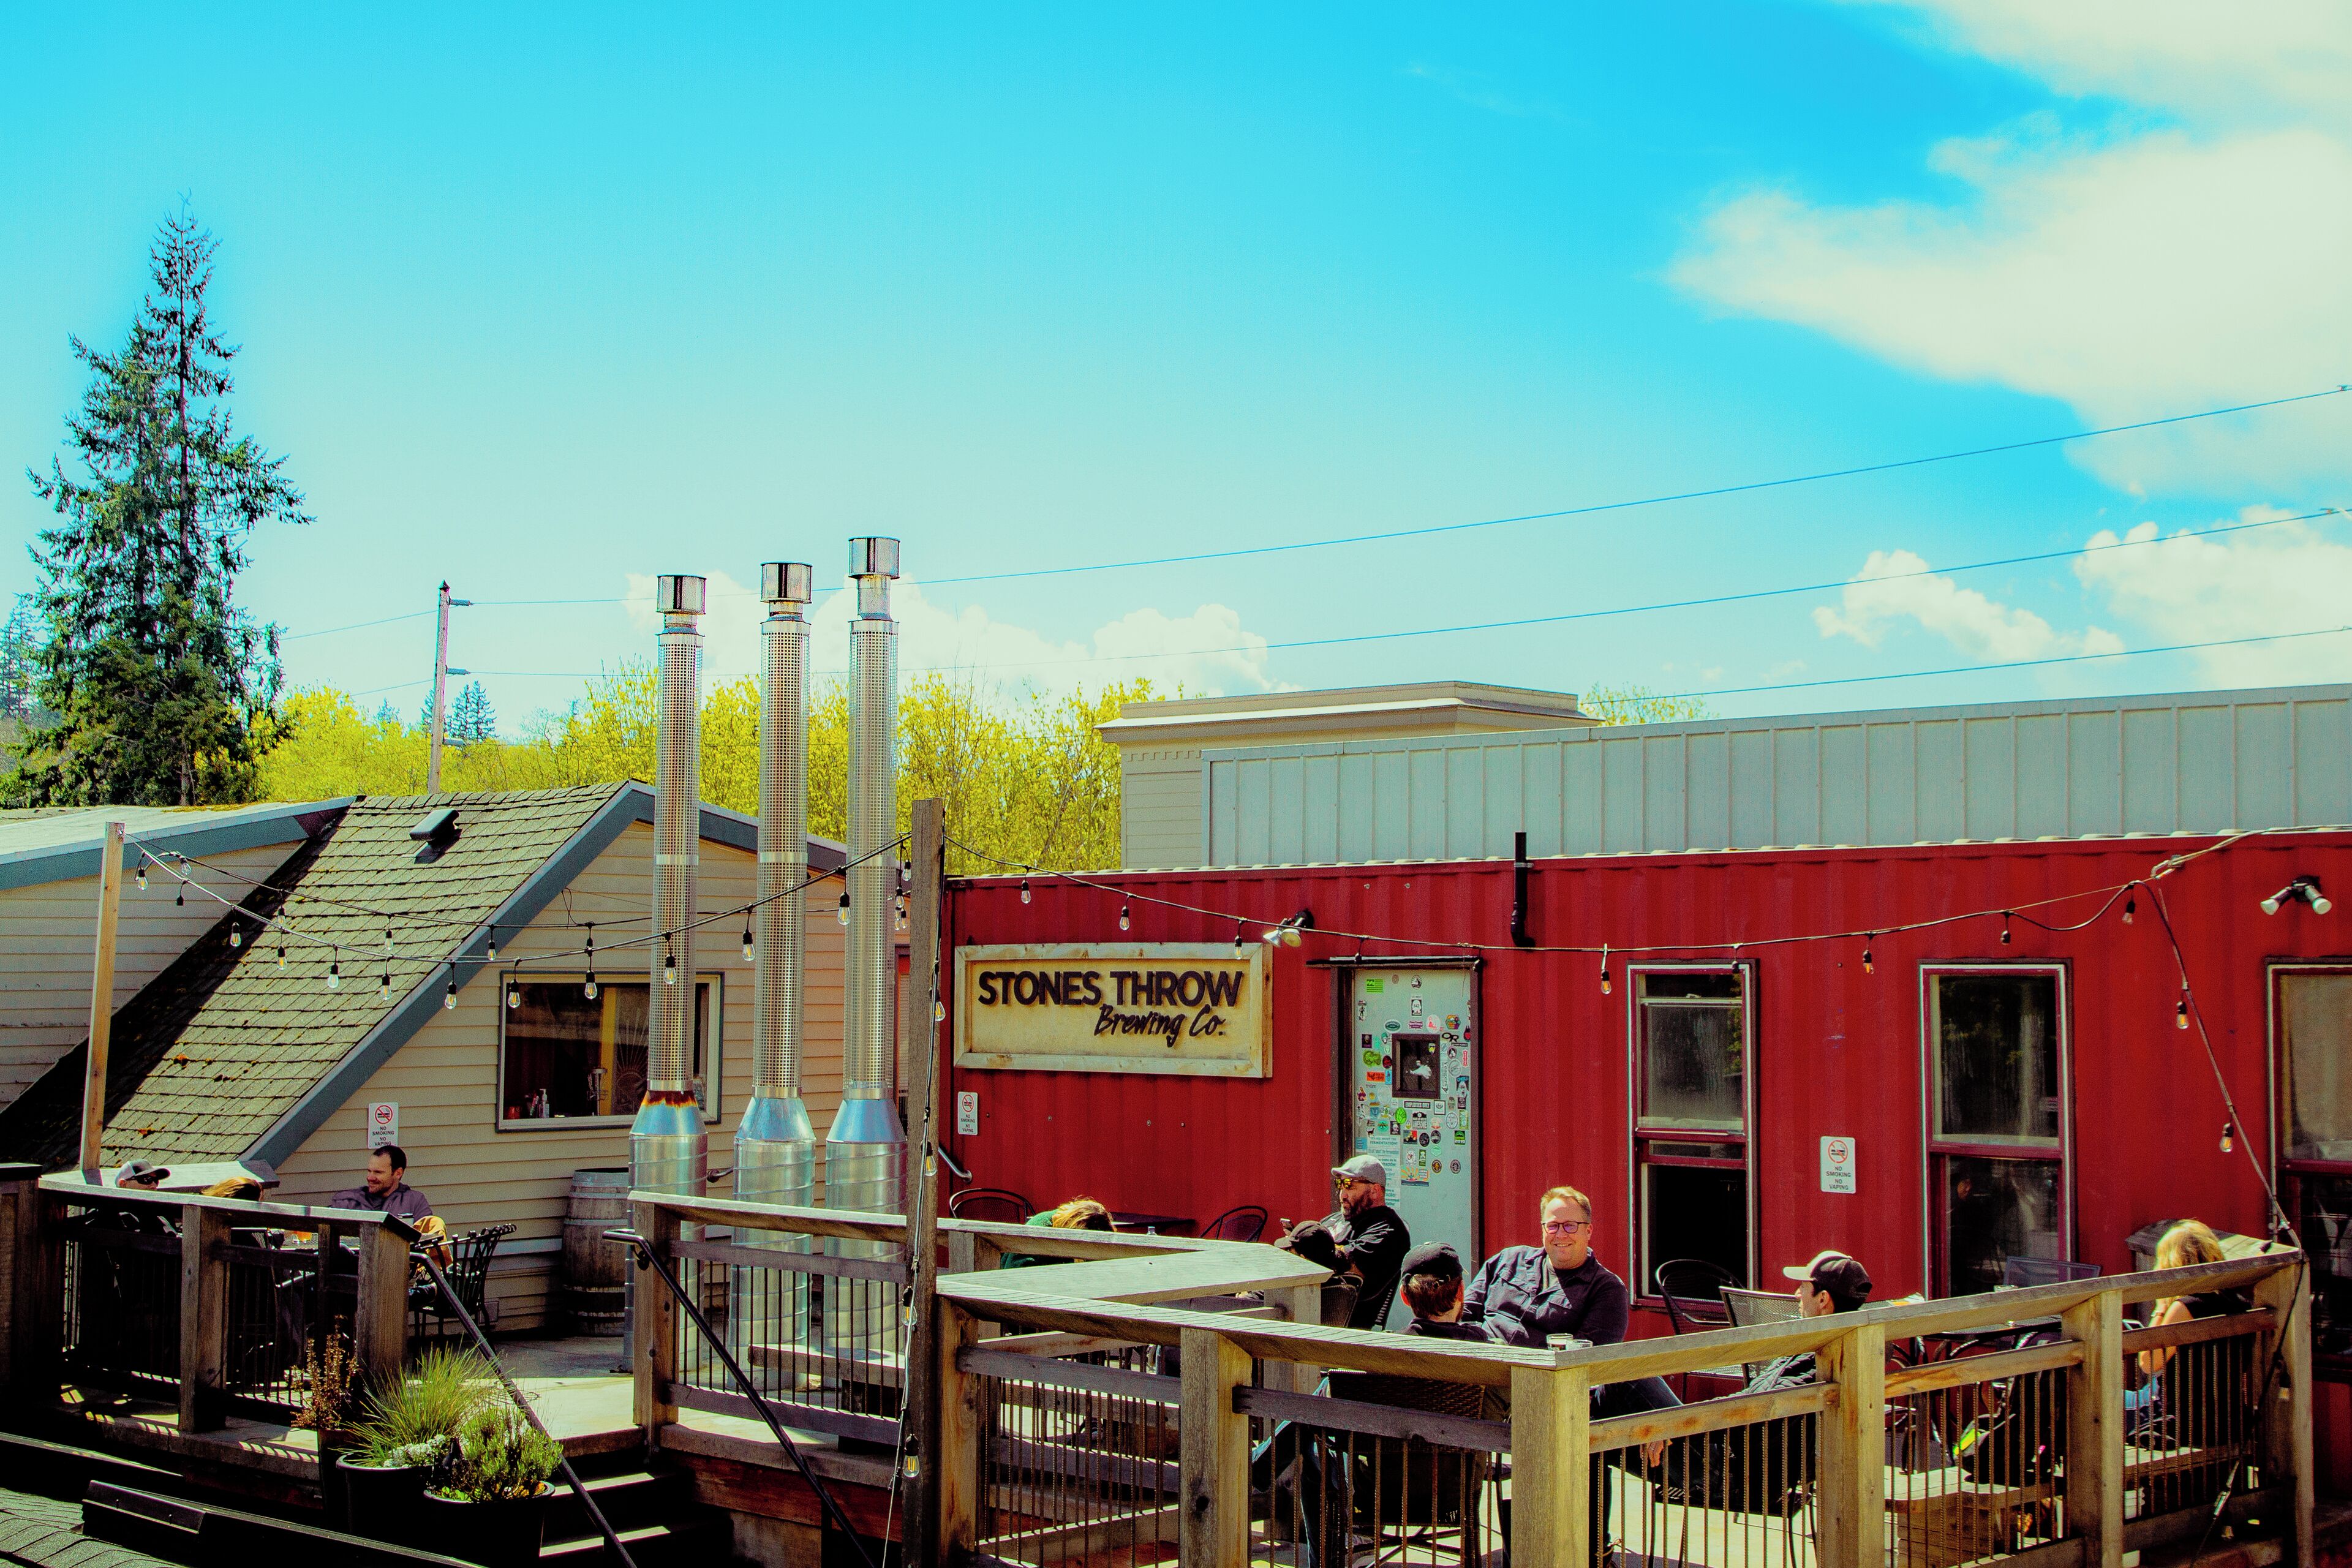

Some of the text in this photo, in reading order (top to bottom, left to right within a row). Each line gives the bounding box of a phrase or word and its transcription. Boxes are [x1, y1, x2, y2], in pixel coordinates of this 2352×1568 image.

[978, 970, 1243, 1007] STONES THROW
[1094, 1003, 1226, 1047] Brewing Co.
